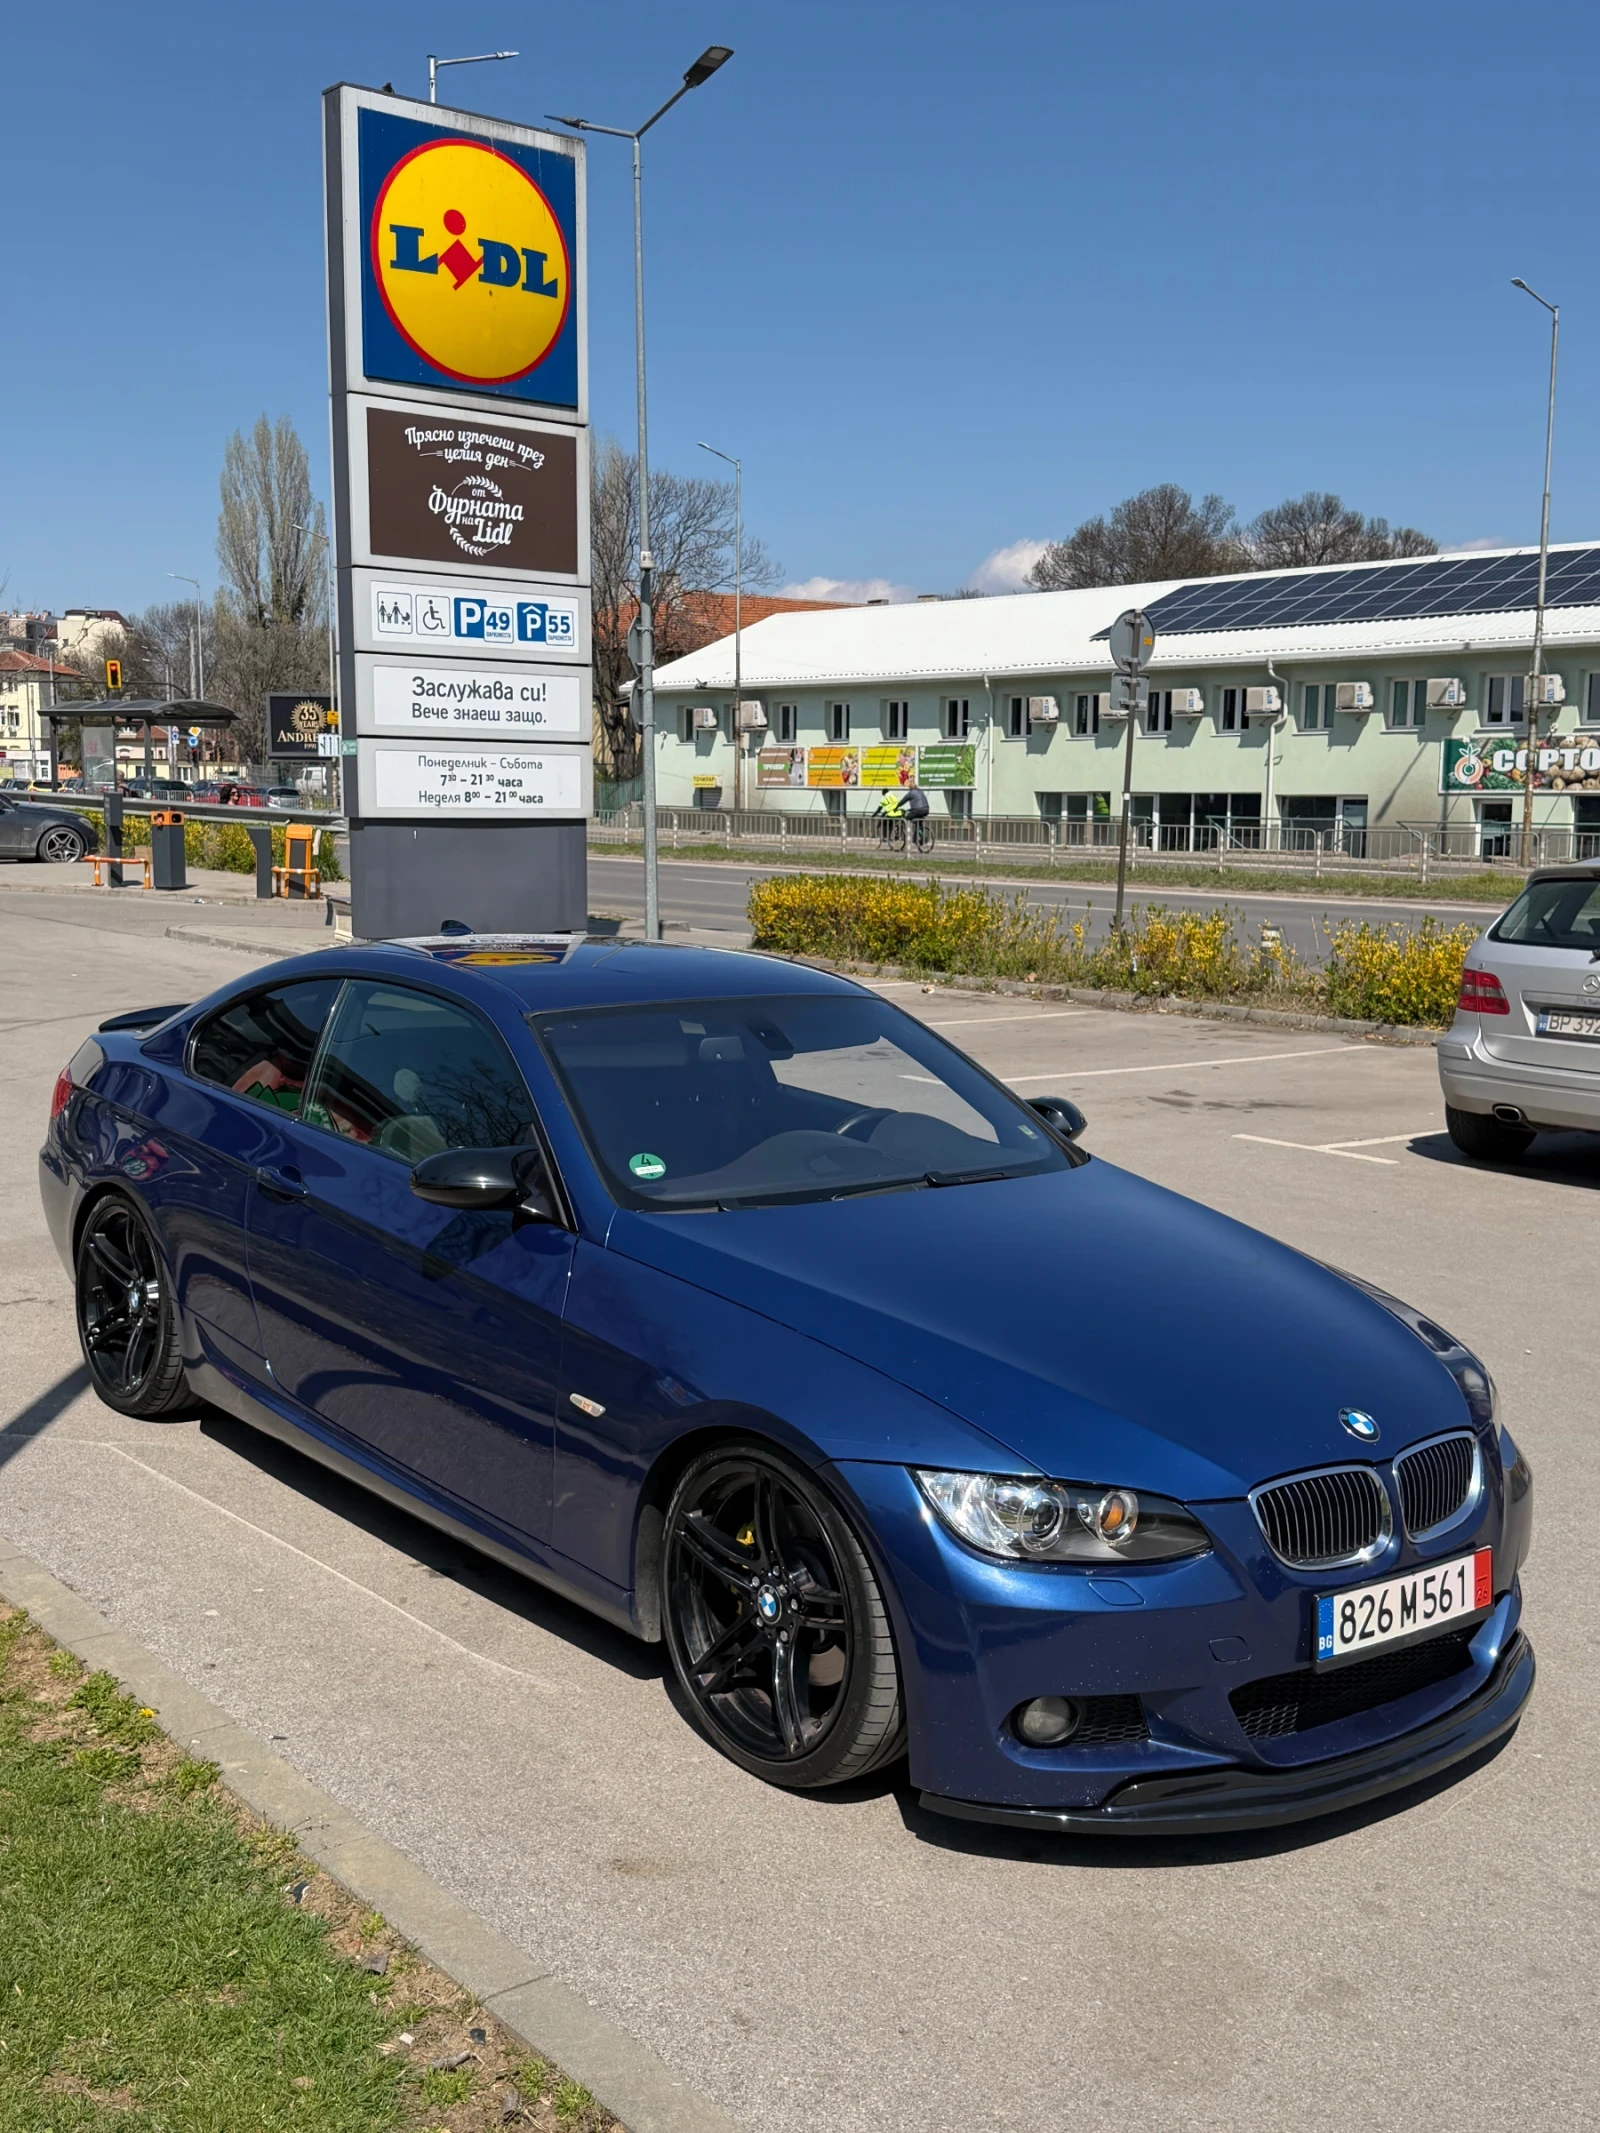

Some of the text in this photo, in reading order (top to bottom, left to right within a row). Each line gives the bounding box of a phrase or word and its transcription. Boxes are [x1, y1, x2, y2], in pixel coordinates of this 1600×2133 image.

[404, 426, 545, 469] Прясно изпечени през
[444, 449, 509, 471] целия ден
[471, 487, 486, 498] от
[428, 485, 524, 525] Фурната
[461, 515, 475, 526] на
[473, 516, 514, 545] Lidl
[460, 601, 481, 635] P
[486, 611, 510, 631] 49
[548, 615, 571, 634] 55
[411, 675, 547, 702] Заслужава си!
[300, 705, 317, 720] 35
[411, 702, 547, 725] Вече знаеш защо.
[300, 720, 319, 728] YEARS
[418, 755, 488, 771] Понеделник
[499, 757, 543, 770] Събота
[498, 777, 523, 788] часа
[418, 790, 461, 807] Неделя
[519, 793, 544, 804] часа
[641, 1154, 652, 1167] 4
[1318, 1634, 1333, 1650] BG
